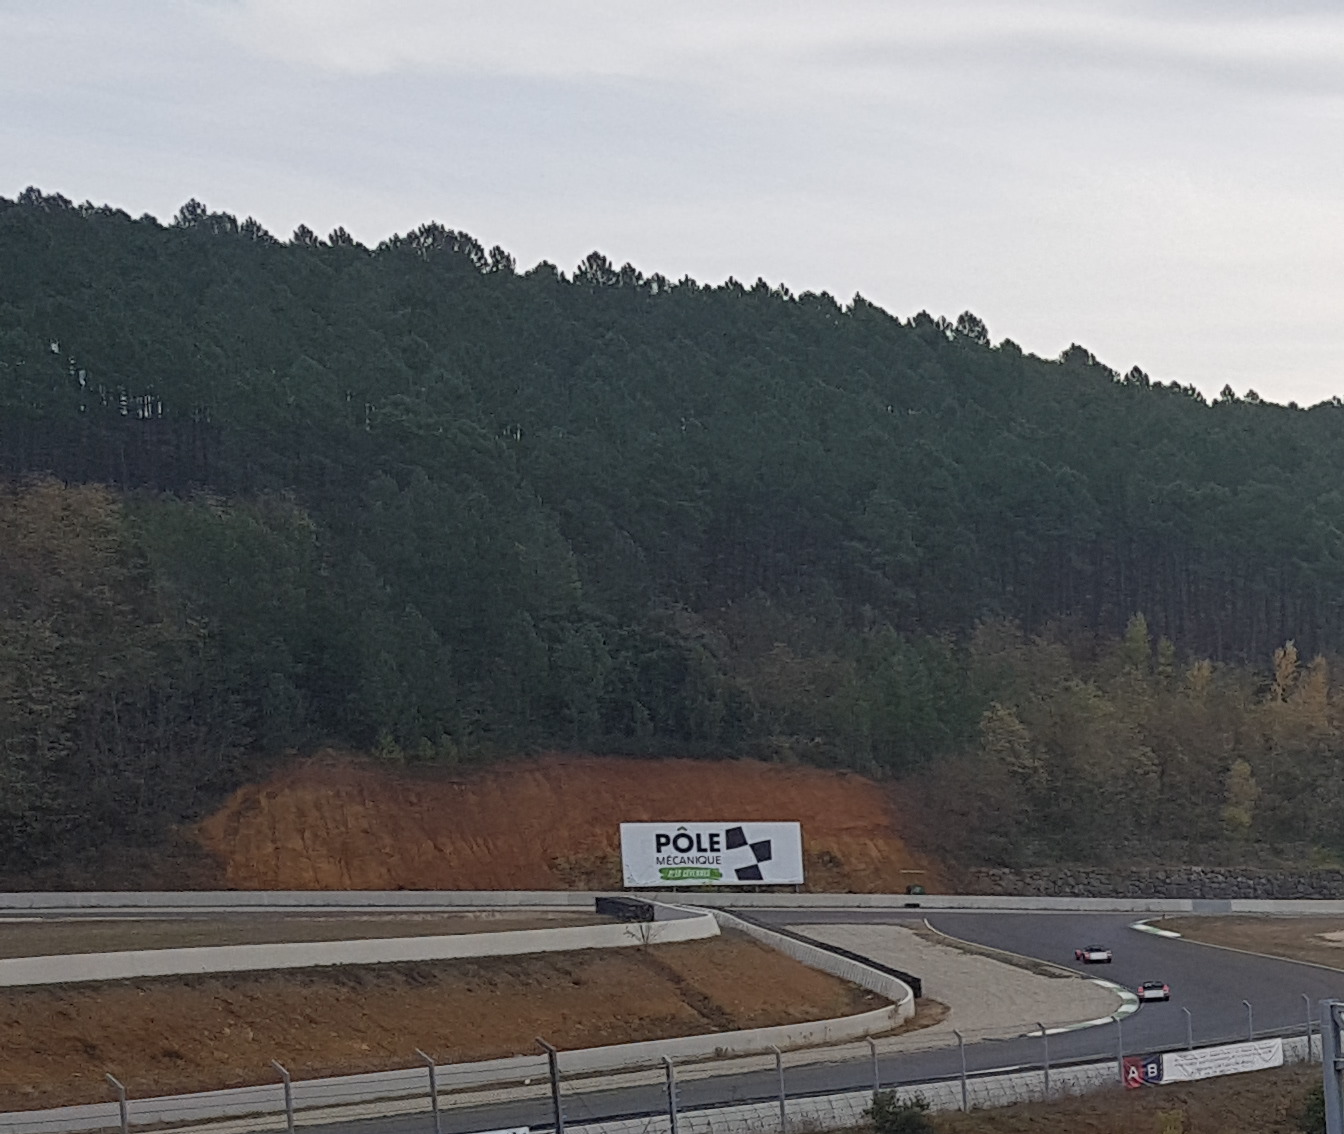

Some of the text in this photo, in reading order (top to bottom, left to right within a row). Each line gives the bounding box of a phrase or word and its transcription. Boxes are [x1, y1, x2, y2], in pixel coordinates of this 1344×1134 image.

[655, 826, 721, 853] PÔLE
[656, 855, 722, 865] MÉCANIQUE
[1147, 1063, 1157, 1077] B
